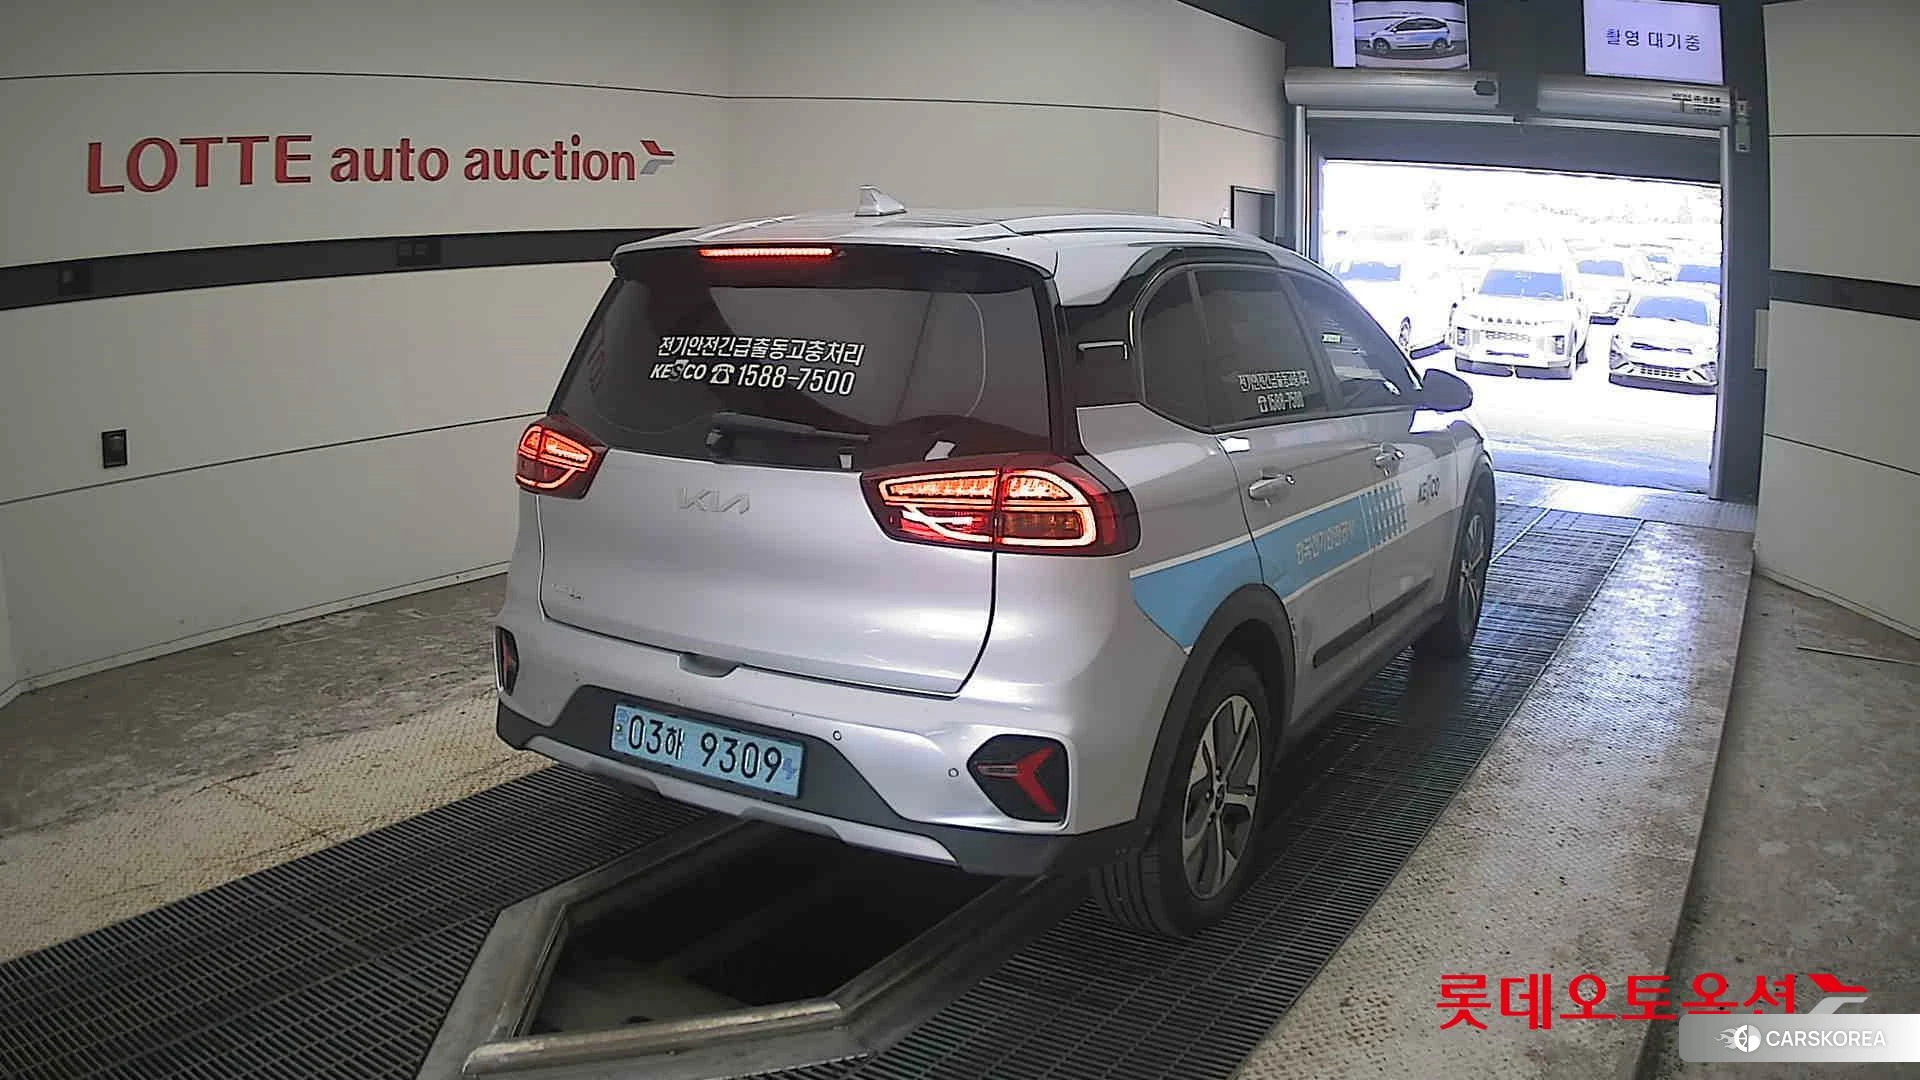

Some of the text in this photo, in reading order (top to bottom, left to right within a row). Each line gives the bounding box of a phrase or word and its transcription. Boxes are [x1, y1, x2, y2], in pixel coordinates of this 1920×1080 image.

[1607, 28, 1701, 52] 촬영 대기중
[87, 134, 637, 195] LOTTE auto auction
[657, 335, 866, 366] 전기안전긴급출동고충처리
[649, 358, 856, 396] KESCO 1588-7500
[678, 487, 750, 514] KIA
[627, 714, 784, 784] 03하 9309
